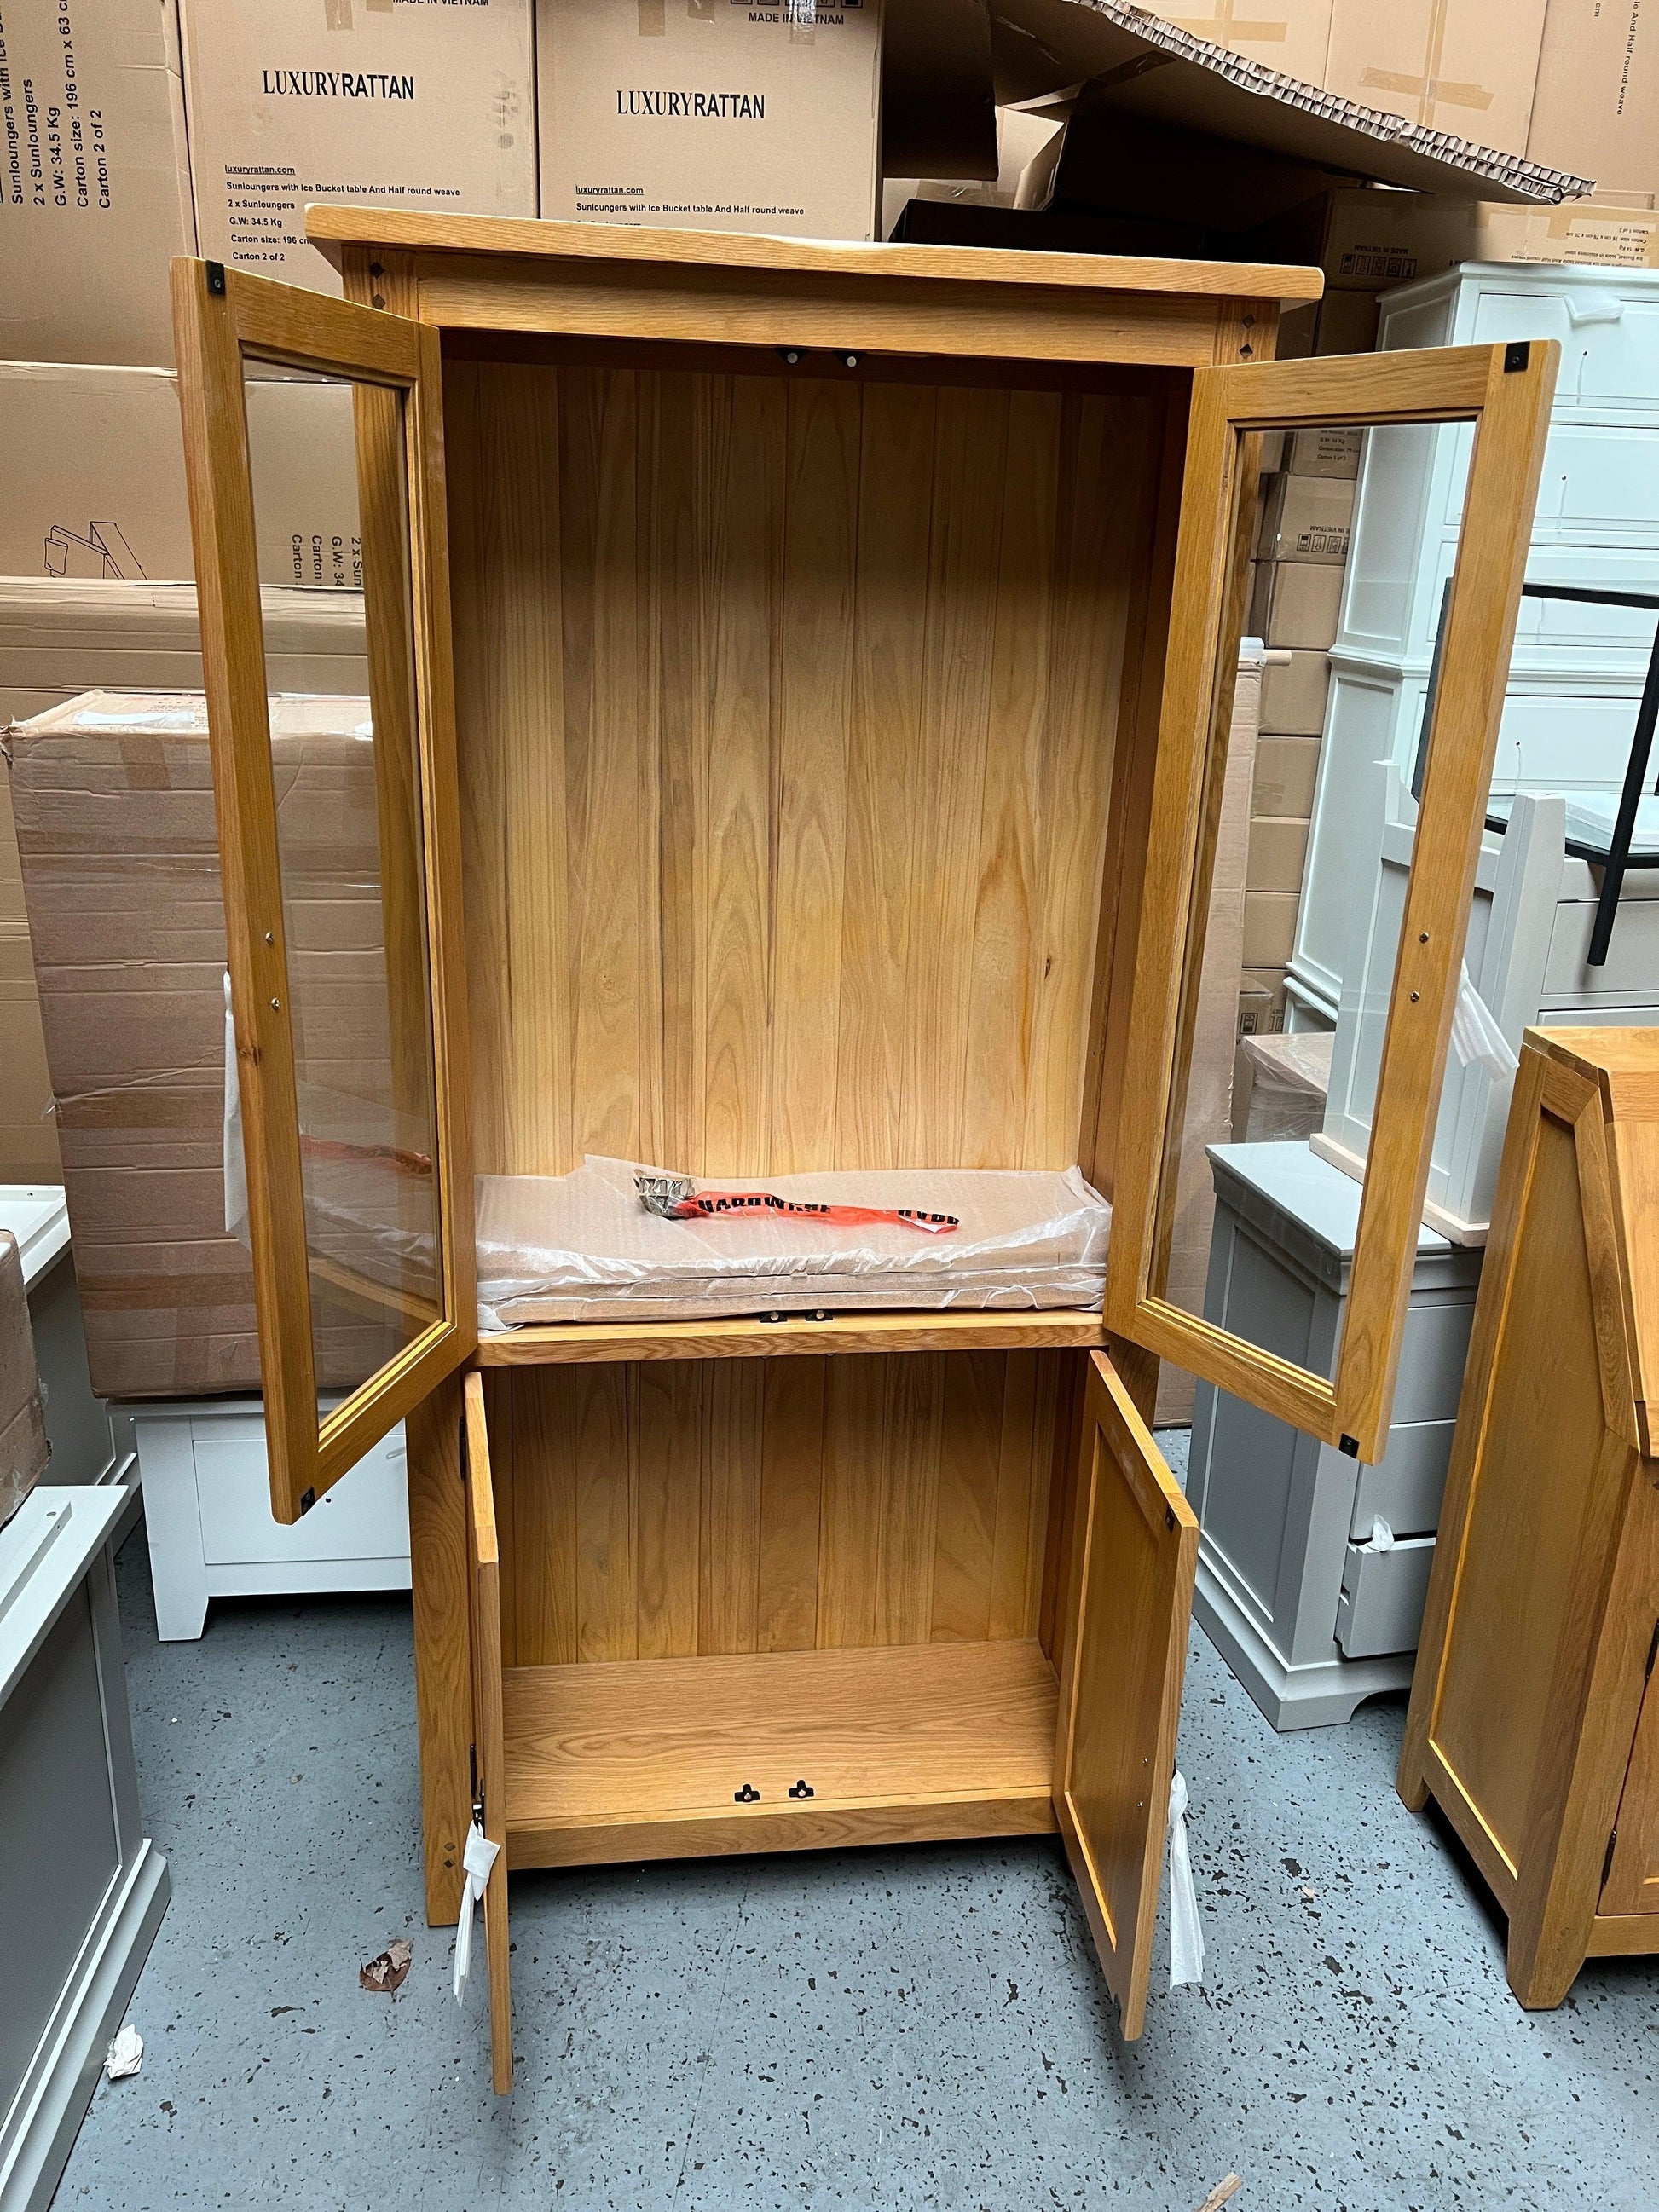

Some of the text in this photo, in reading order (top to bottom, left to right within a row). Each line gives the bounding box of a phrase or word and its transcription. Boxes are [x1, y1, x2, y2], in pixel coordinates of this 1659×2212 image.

[748, 13, 844, 25] MADE IN VIETNAM
[1594, 3, 1601, 17] cm
[1629, 12, 1639, 32] And
[1627, 34, 1636, 54] Half
[1621, 55, 1631, 84] round
[0, 67, 12, 101] with
[262, 70, 414, 100] LUXURYRATTAN
[58, 0, 88, 208] Carton size: 196 cm x 63 c
[616, 90, 765, 118] LUXURYRATTAN
[1616, 86, 1626, 115] weave
[4, 106, 23, 204] Sunloungers
[23, 78, 45, 205] 2 x Sunloungers
[47, 107, 66, 206] G.W: 34.5 Kg
[90, 109, 111, 208] Carton 2 of 2
[224, 164, 296, 175] luxuryrattan.com
[226, 182, 280, 193] Sunloungers
[281, 183, 299, 192] with
[301, 183, 314, 192] Ice
[315, 183, 345, 193] Bucket
[346, 184, 367, 193] table
[369, 185, 386, 193] And
[388, 186, 405, 194] Half
[407, 186, 431, 195] round
[575, 186, 644, 195] luxuryrattan.com
[228, 199, 233, 207] 2
[242, 199, 295, 210] Sunloungers
[576, 203, 627, 213] Sunloungers
[692, 205, 713, 213] table
[733, 205, 750, 214] Half
[229, 217, 282, 228] G.W: 34.5 Kg
[231, 234, 259, 244] Carton
[261, 235, 280, 244] size:
[282, 235, 297, 245] 196
[232, 251, 260, 261] Carton
[262, 252, 268, 261] 2
[269, 252, 279, 261] of
[292, 534, 303, 579] Carton
[312, 535, 323, 580] Carton
[332, 536, 344, 568] G.W:
